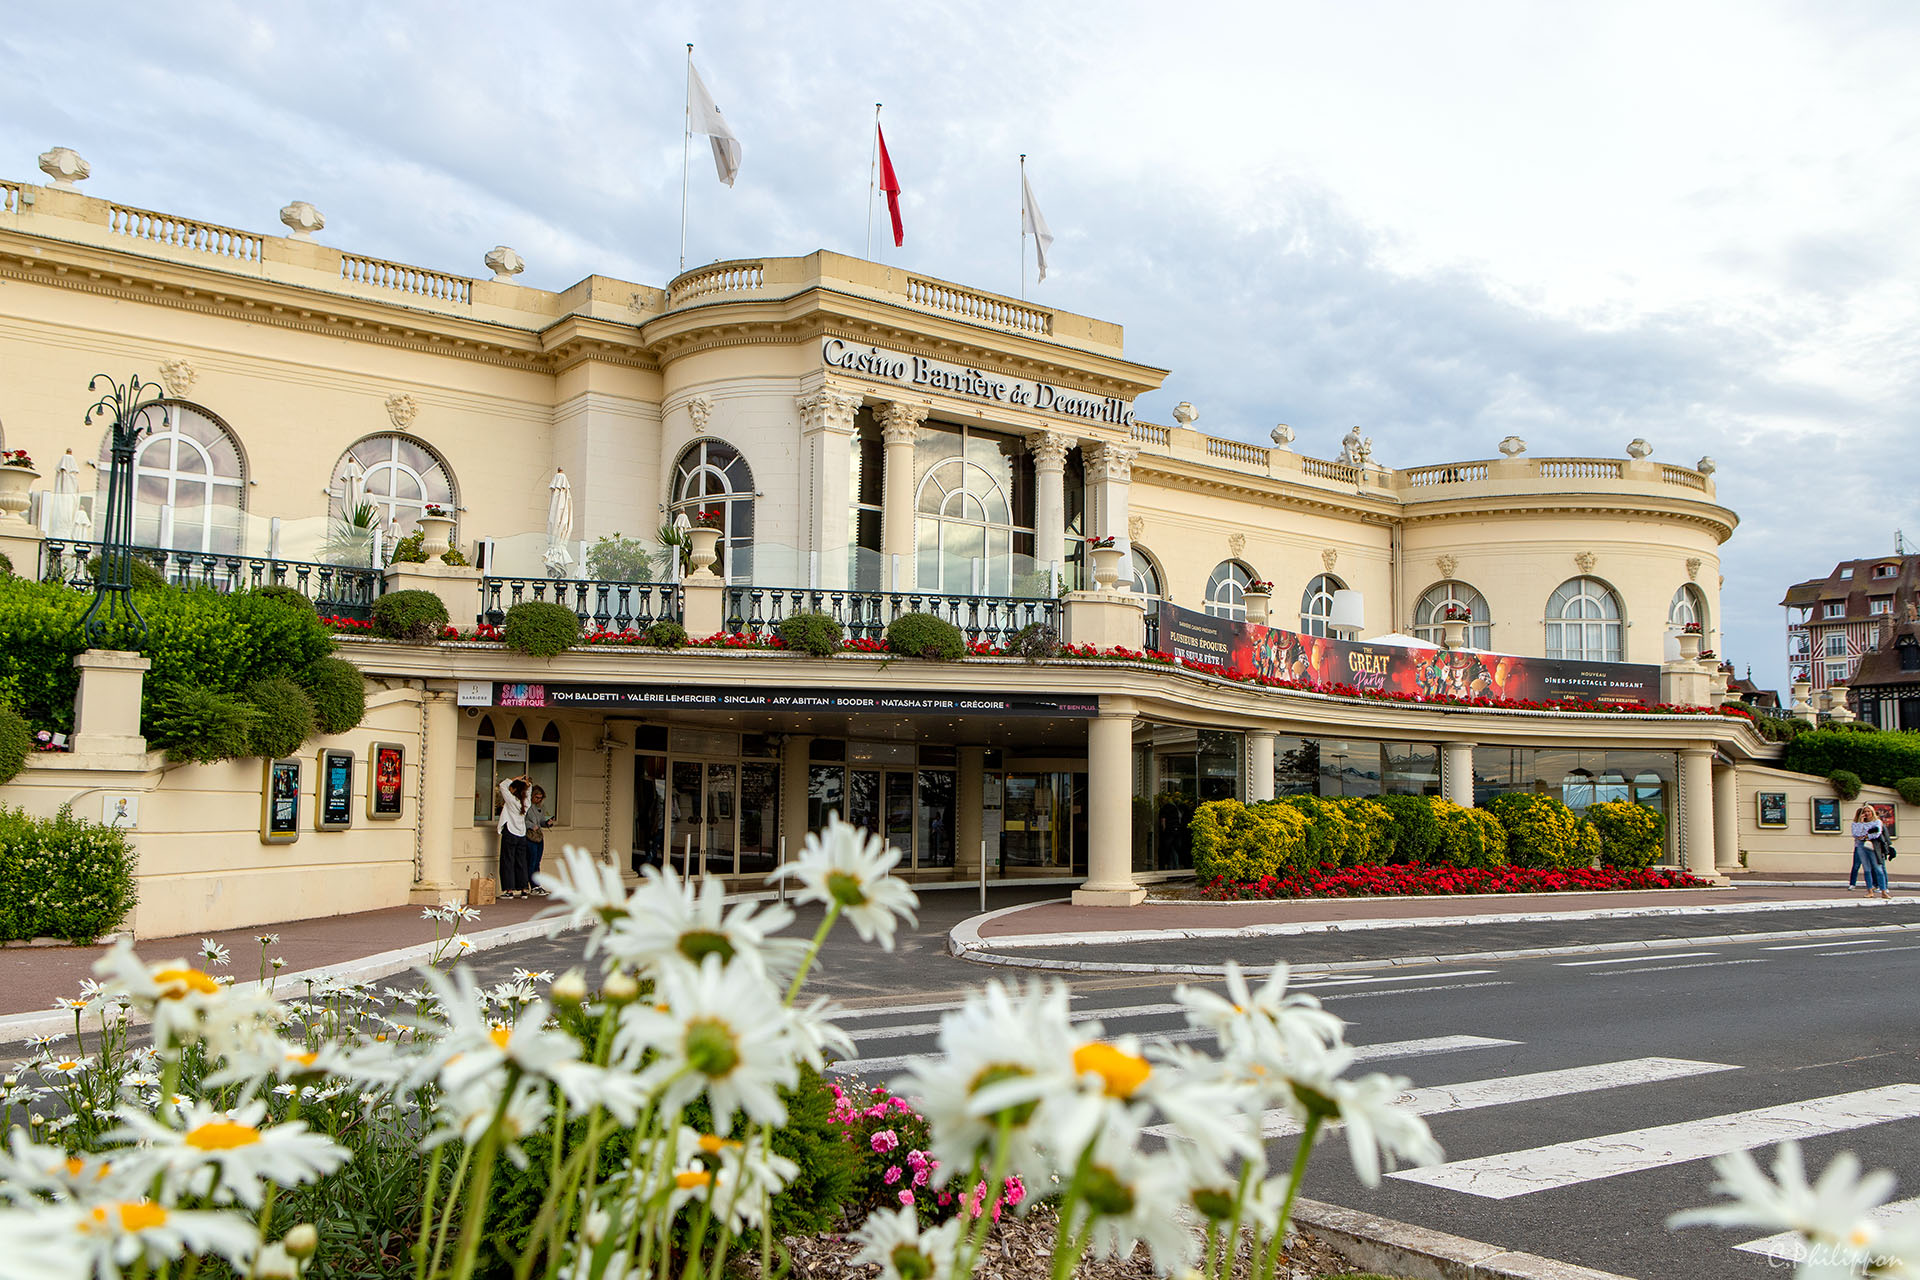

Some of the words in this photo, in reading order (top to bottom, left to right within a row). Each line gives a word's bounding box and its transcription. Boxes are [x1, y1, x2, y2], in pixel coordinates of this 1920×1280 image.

[823, 338, 907, 379] Casino
[912, 355, 1007, 400] Barrière
[1009, 384, 1032, 406] de
[1035, 382, 1136, 426] Deauville
[1170, 631, 1199, 648] PLUSIEURS
[1199, 637, 1229, 654] ÉPOQUES,
[1204, 653, 1220, 665] FÊTE
[1348, 651, 1391, 675] GREAT
[1352, 668, 1386, 692] Party
[1544, 677, 1607, 687] DÎNER-SPECTACLE
[1609, 681, 1644, 689] DANSANT
[501, 684, 545, 700] SAISON
[552, 692, 574, 700] TOM
[575, 692, 619, 701] BALDETTI
[627, 692, 664, 702] VALÉRIE
[665, 694, 717, 703] LEMERCIER
[723, 695, 766, 704] SINCLAIR
[772, 697, 791, 705] ARY
[791, 697, 830, 706] ABITTAN
[836, 698, 874, 707] BOODER
[881, 699, 922, 708] NATASHA
[922, 700, 933, 708] ST
[934, 700, 953, 708] PIER
[960, 700, 1004, 709] GRÉGOIRE
[500, 699, 545, 708] ARTISTIQUE
